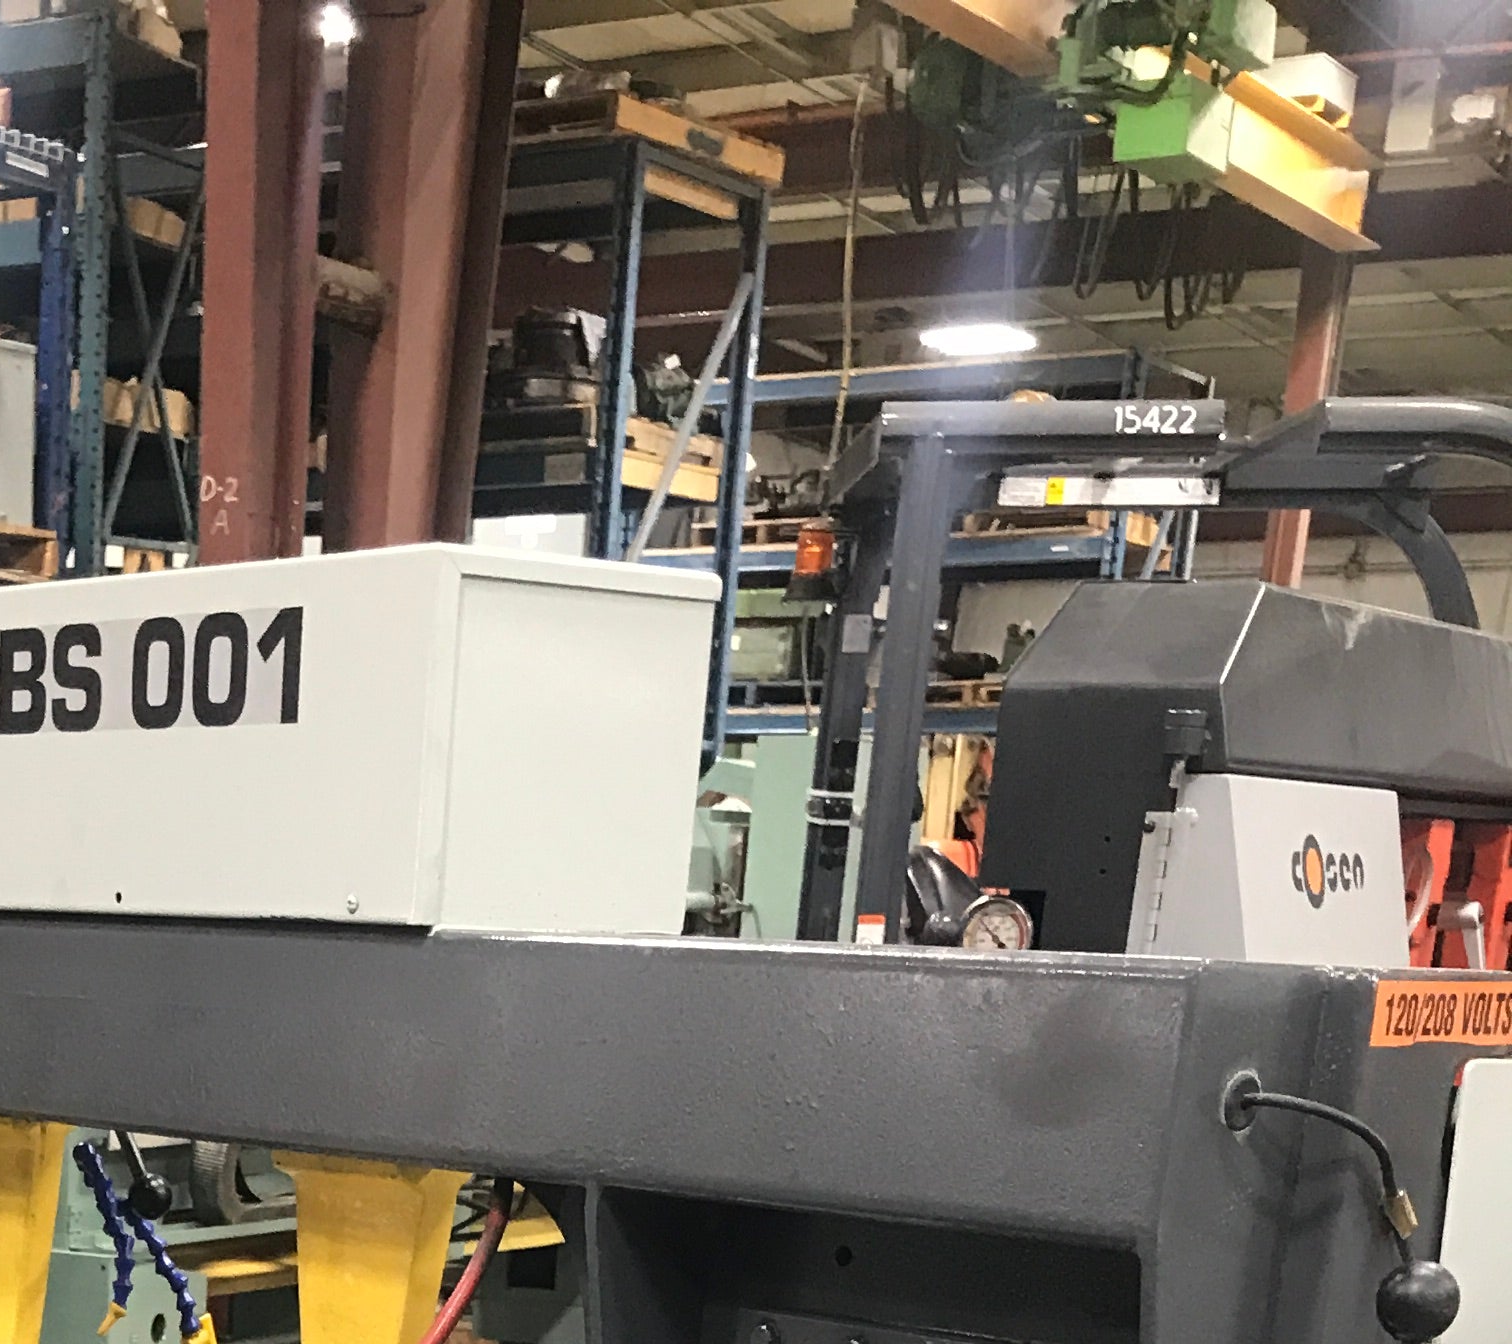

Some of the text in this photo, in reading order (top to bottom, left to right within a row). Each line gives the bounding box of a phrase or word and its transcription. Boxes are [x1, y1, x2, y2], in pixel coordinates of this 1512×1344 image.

[1114, 405, 1197, 434] 15422
[200, 475, 238, 502] D-2
[209, 509, 230, 536] A
[132, 606, 303, 730] 001
[1385, 991, 1512, 1042] 120/208 VOLTS
